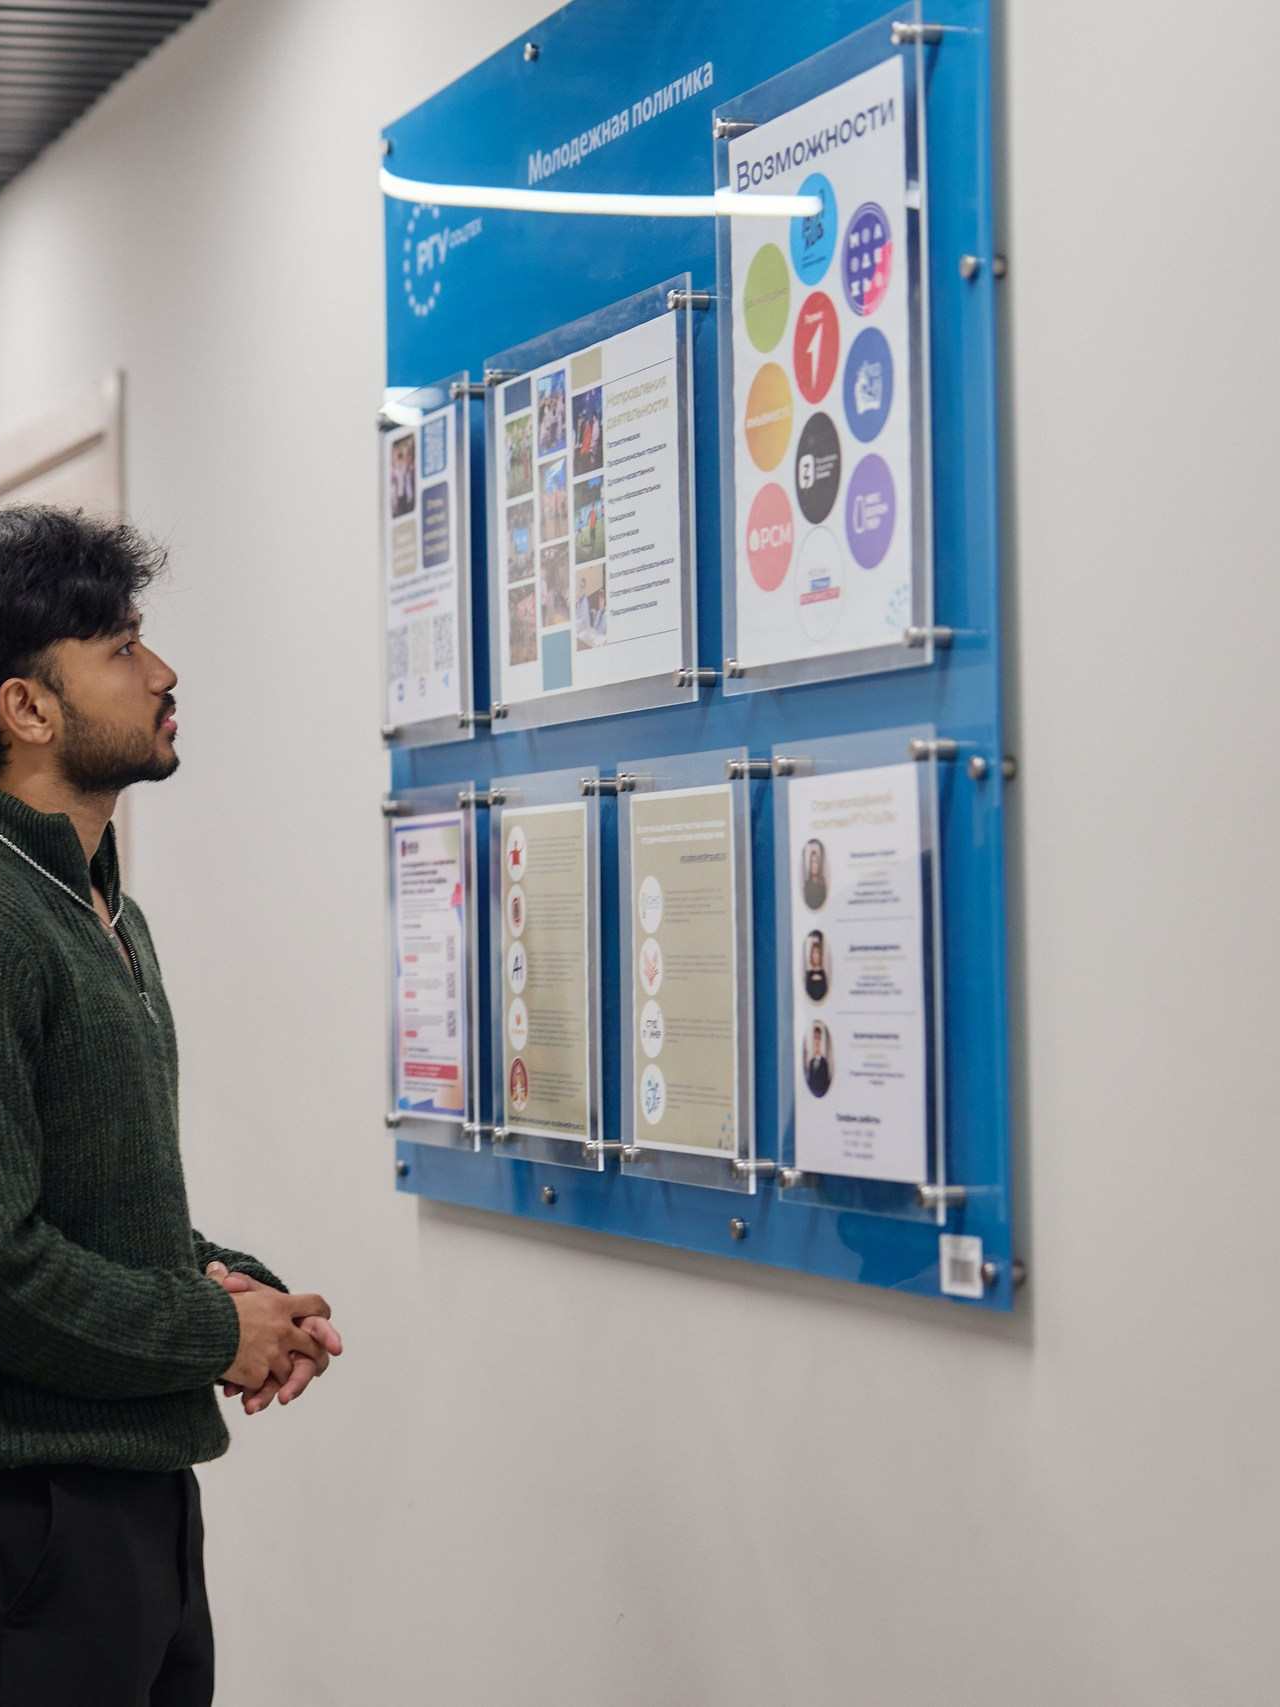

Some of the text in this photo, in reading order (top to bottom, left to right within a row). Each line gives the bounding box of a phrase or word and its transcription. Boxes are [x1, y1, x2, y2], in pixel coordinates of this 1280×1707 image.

[528, 61, 714, 185] Молодежная политика
[736, 98, 895, 193] Возможности
[416, 226, 449, 277] РГУ
[760, 521, 793, 550] РСМ
